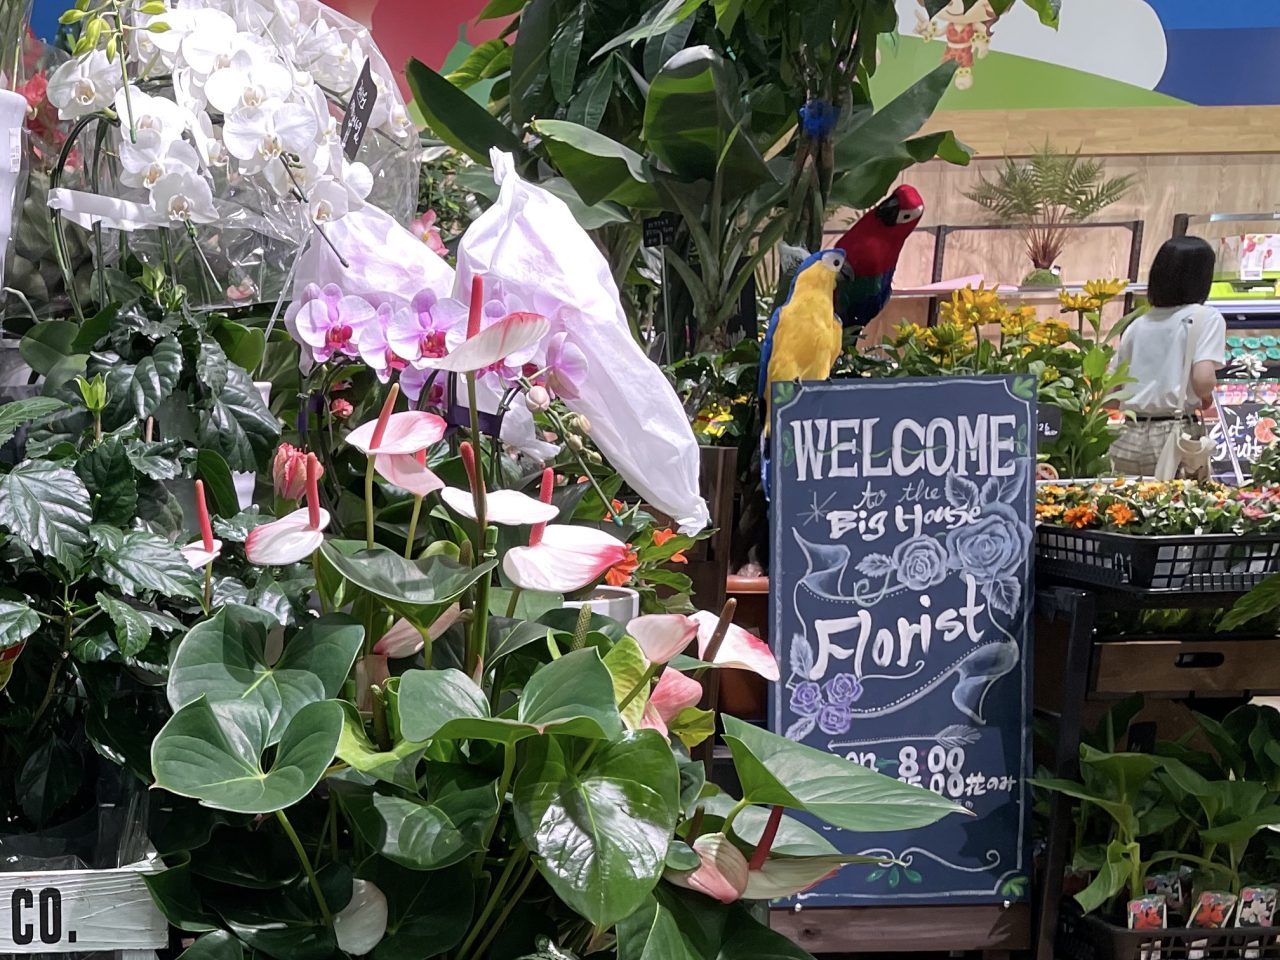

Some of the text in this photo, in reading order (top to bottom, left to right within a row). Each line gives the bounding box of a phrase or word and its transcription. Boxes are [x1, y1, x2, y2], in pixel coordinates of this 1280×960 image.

[790, 414, 1017, 481] WELCOME
[826, 502, 983, 542] Big House
[853, 478, 942, 510] to the
[808, 573, 986, 681] Florist
[11, 886, 78, 946] CO.
